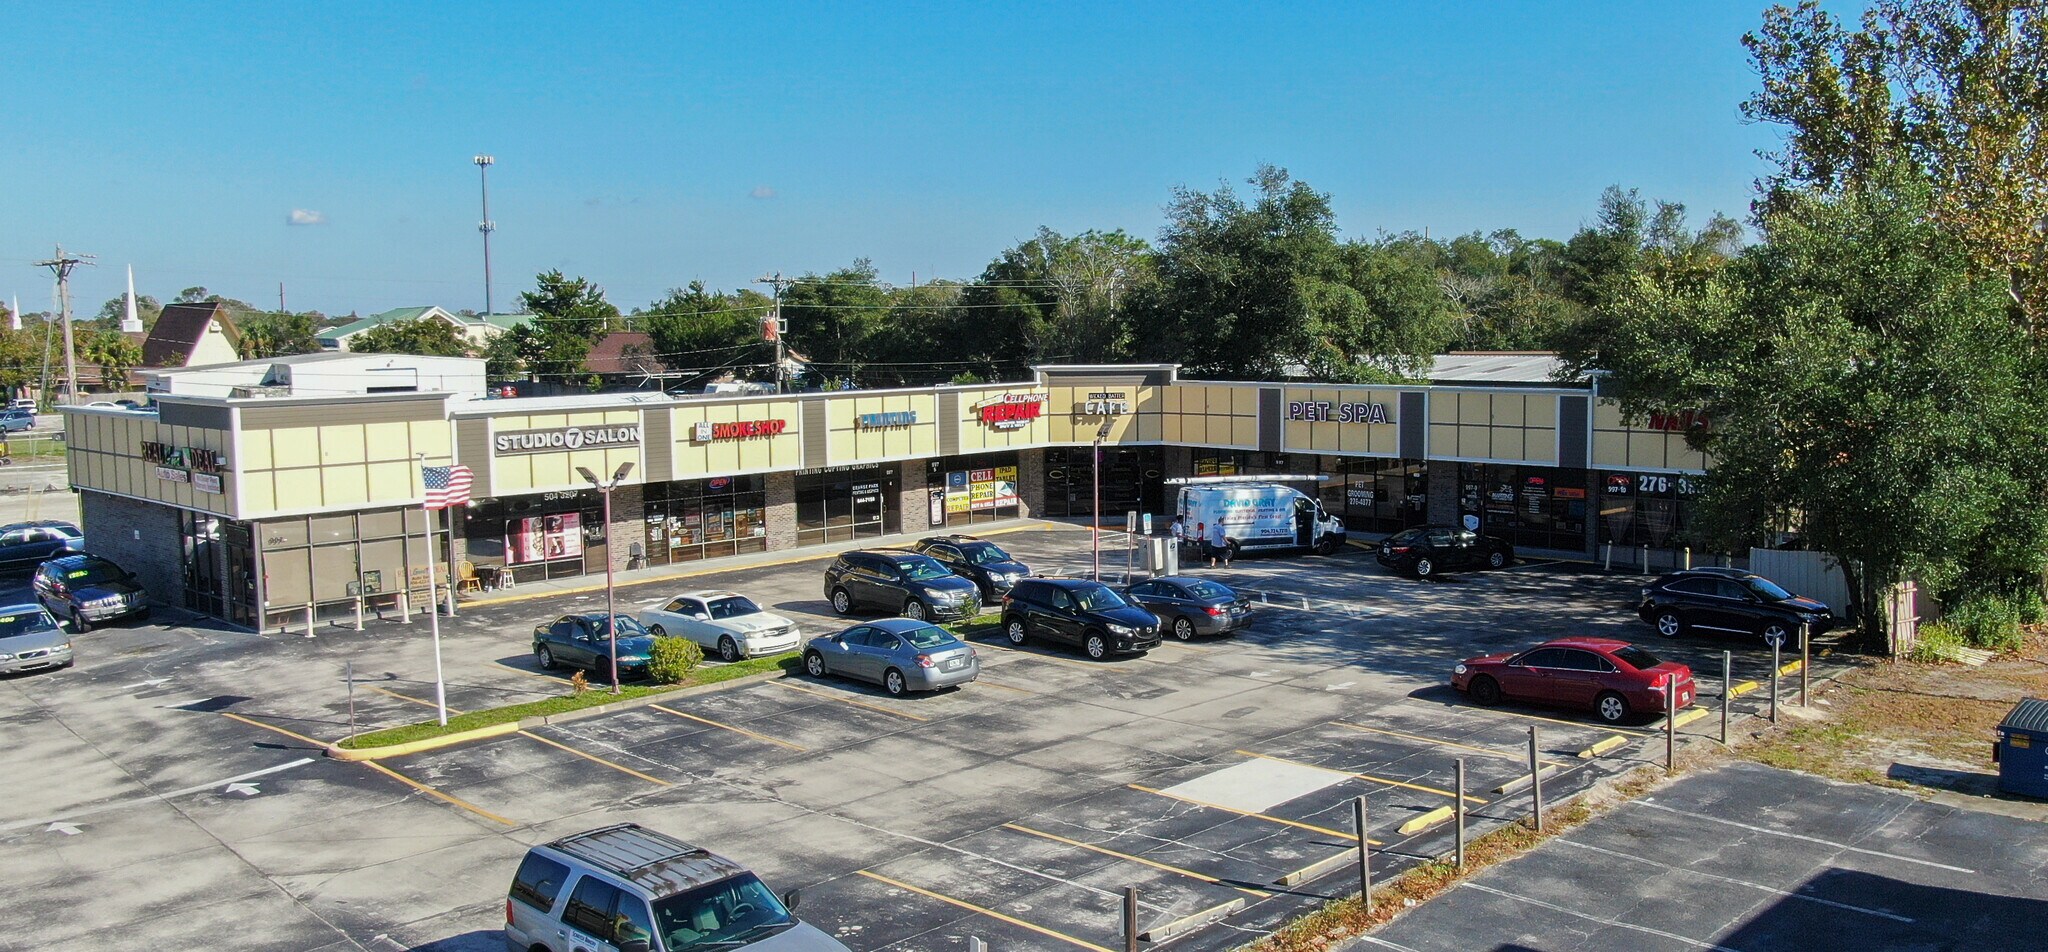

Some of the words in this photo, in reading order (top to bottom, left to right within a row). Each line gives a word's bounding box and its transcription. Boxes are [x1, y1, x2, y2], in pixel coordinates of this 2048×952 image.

[1004, 393, 1049, 404] CELLPHONE
[982, 401, 1041, 422] REPAIR
[1085, 400, 1128, 415] CAFE
[1289, 401, 1330, 422] PET
[1338, 402, 1387, 424] SPA
[712, 421, 754, 440] SMOKE
[754, 419, 786, 436] SHOP
[497, 432, 564, 450] STUDIO
[584, 427, 640, 445] SALON
[141, 441, 165, 463] REAL
[191, 448, 216, 472] DEAL
[970, 470, 993, 482] CELL
[710, 477, 728, 487] OPEN
[970, 482, 994, 491] PHONE
[1354, 480, 1364, 489] PET
[544, 492, 559, 502] 504
[947, 495, 969, 503] COMPUTER
[970, 490, 994, 500] REPAIR
[1347, 489, 1374, 499] GROOMING
[946, 503, 970, 511] REPAIR
[995, 498, 1017, 507] REPAIR
[1223, 499, 1251, 508] DAVID
[1252, 498, 1276, 508] GRAY
